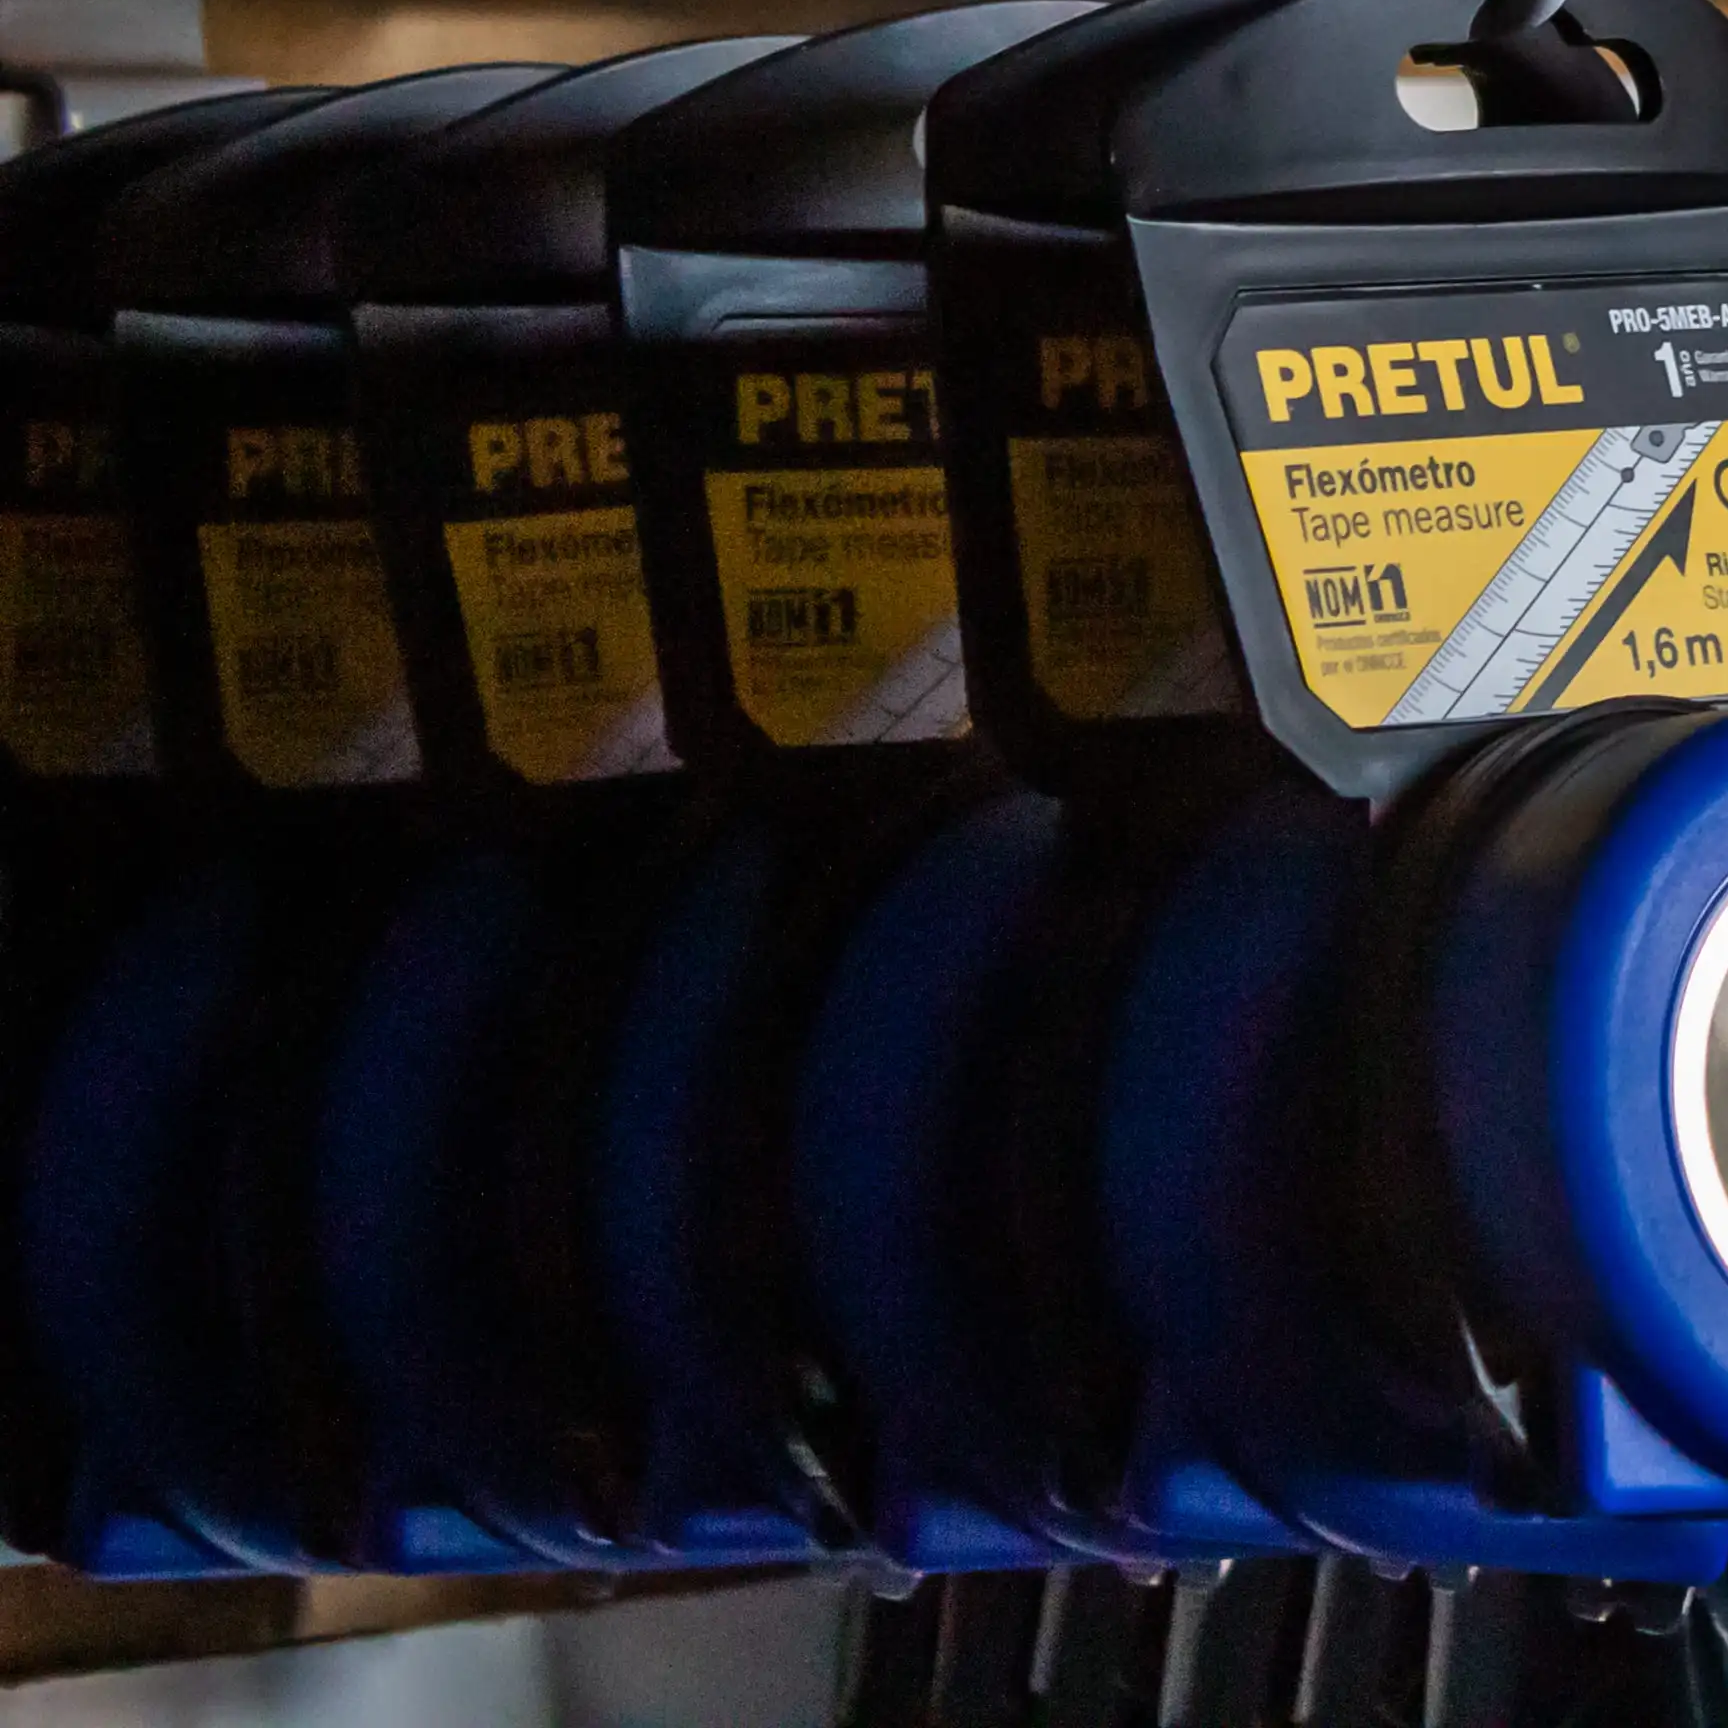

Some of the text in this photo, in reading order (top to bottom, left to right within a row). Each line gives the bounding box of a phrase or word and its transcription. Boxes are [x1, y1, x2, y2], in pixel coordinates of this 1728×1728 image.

[1255, 334, 1584, 422] PRETUL
[1654, 341, 1684, 398] 1
[1284, 457, 1476, 501] Flexómetro
[1294, 498, 1526, 550] Tape measure
[1305, 574, 1365, 620] NOM
